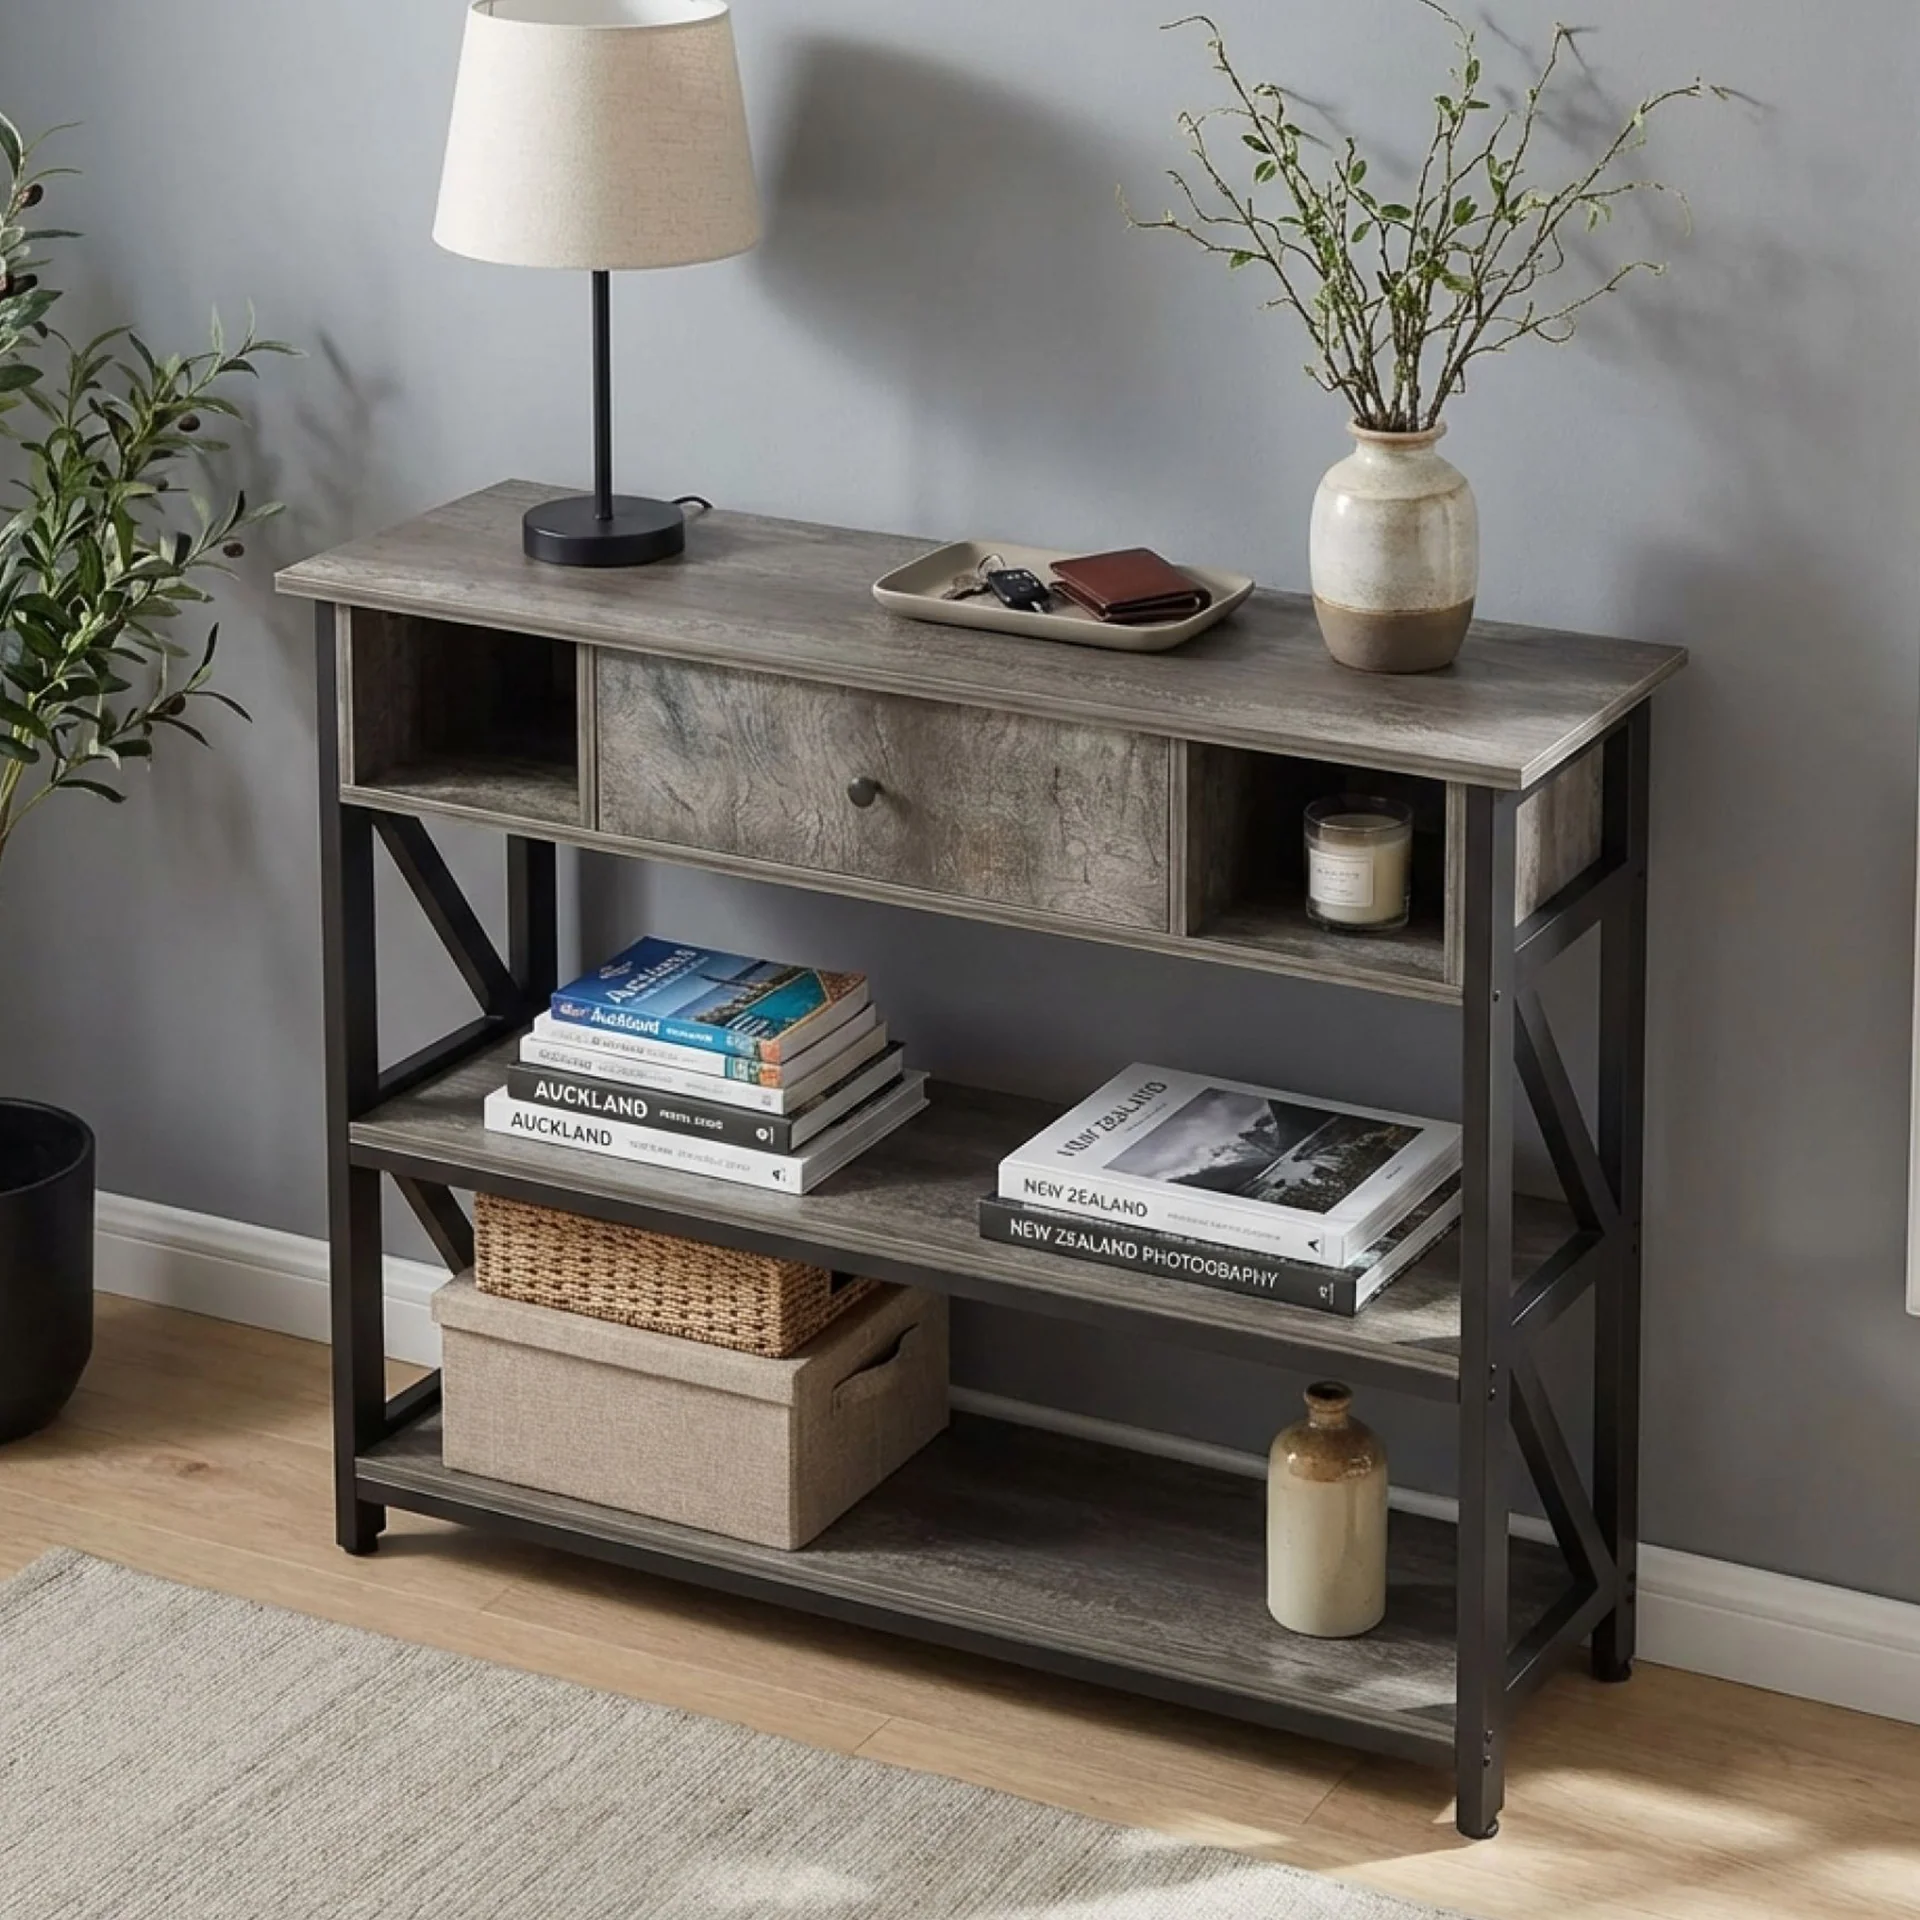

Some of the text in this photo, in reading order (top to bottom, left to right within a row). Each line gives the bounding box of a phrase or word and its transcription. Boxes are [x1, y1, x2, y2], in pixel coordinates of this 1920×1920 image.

[534, 1080, 648, 1119] AUCKLAND
[511, 1112, 612, 1146] AUCKLAND
[1024, 1178, 1064, 1199] NEW
[1010, 1218, 1051, 1241] NEW
